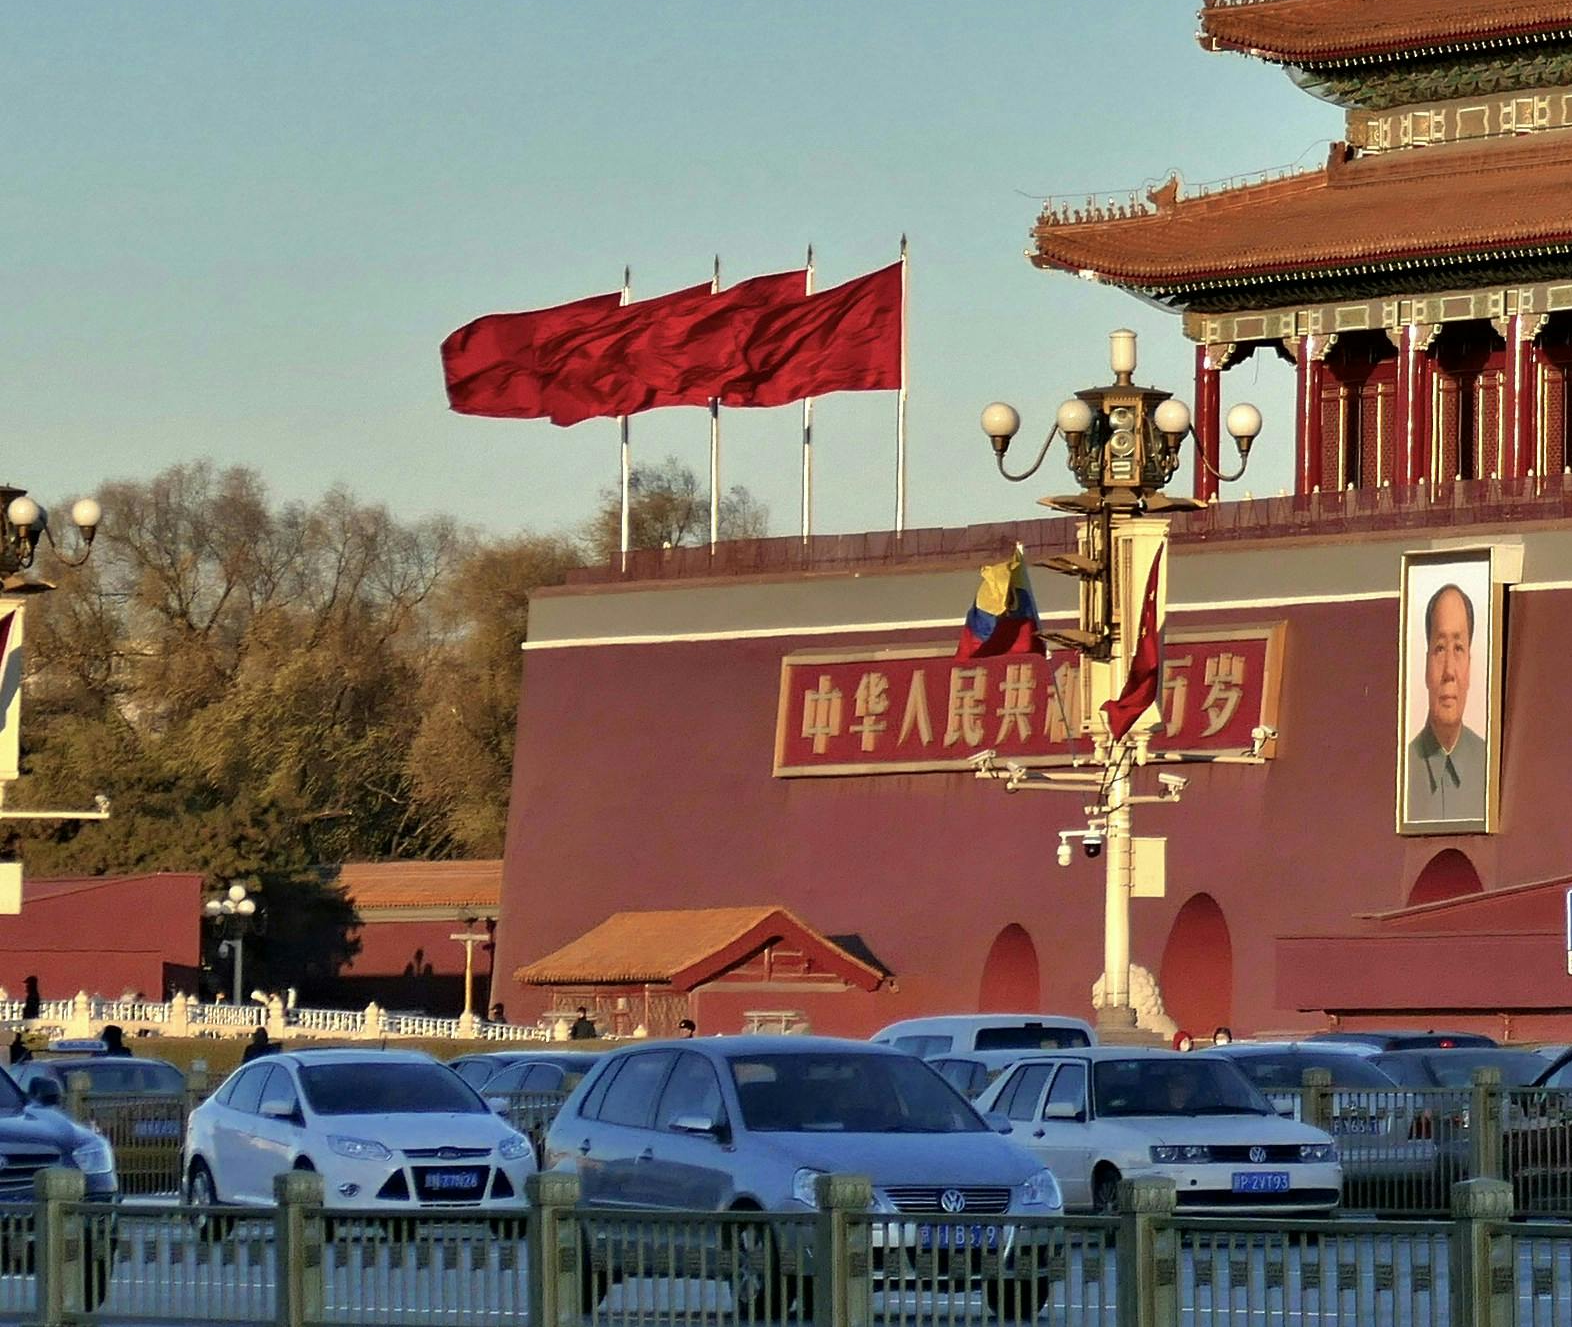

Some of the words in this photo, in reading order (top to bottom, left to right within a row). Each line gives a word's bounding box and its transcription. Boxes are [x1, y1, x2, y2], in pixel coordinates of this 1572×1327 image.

[801, 653, 1245, 754] 中华人民共和万岁
